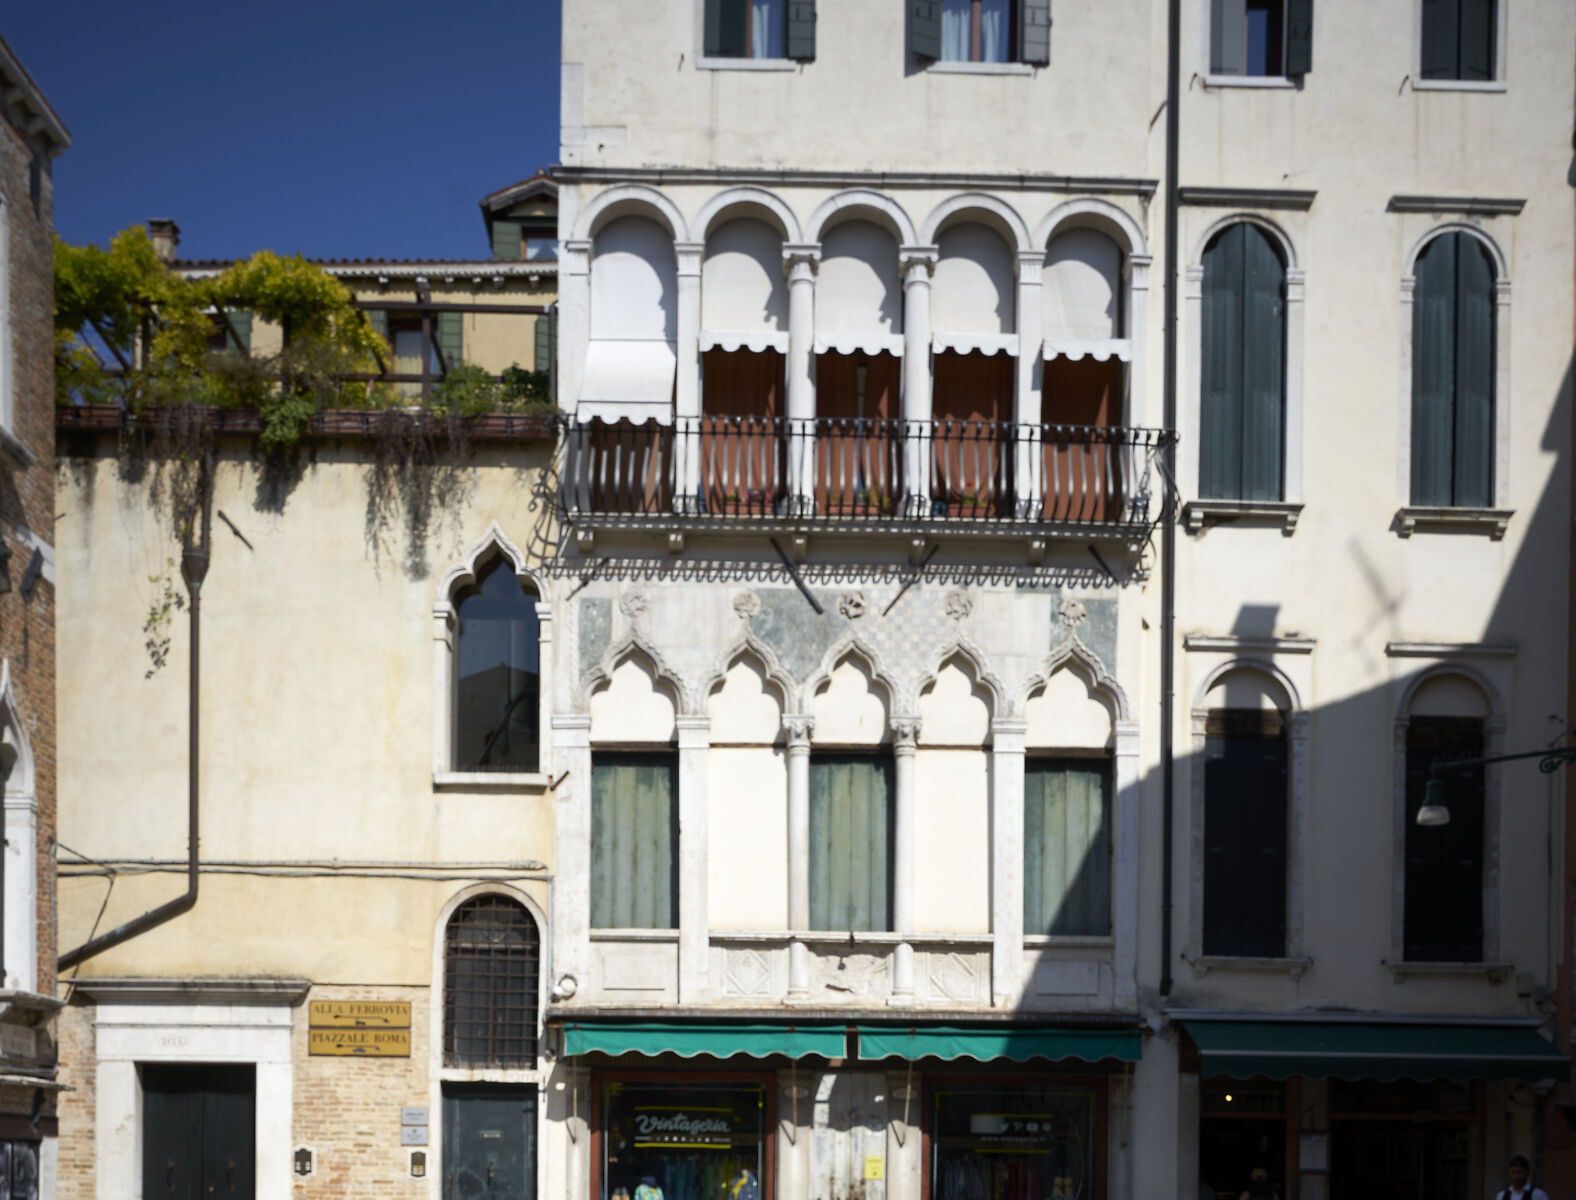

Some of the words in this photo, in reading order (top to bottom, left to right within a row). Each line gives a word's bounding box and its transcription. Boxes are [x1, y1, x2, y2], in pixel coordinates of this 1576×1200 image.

[313, 1004, 344, 1014] ALLA
[349, 1004, 408, 1015] FERROVIA
[312, 1032, 368, 1043] PIAZZALE
[374, 1033, 407, 1044] ROMA
[635, 1113, 731, 1135] Vintageria
